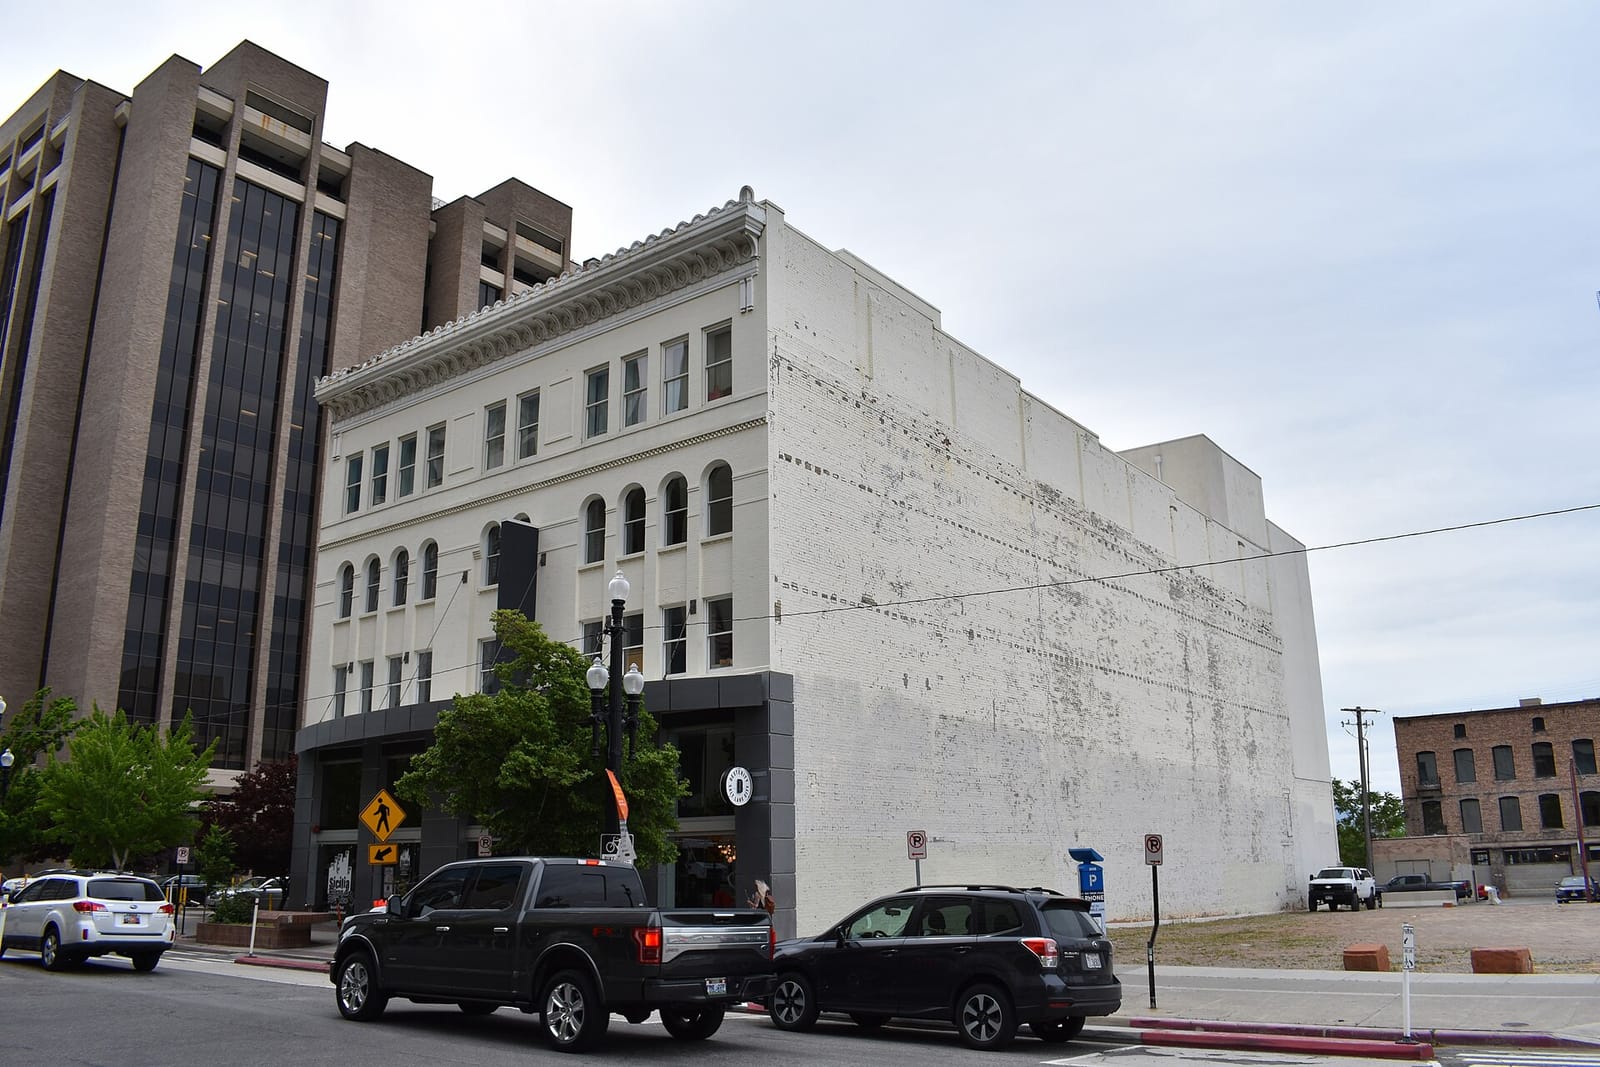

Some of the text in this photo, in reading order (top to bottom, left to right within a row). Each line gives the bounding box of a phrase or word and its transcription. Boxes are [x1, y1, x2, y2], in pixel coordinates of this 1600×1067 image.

[736, 778, 744, 794] D
[328, 875, 350, 889] Sicilia
[1088, 874, 1097, 887] P
